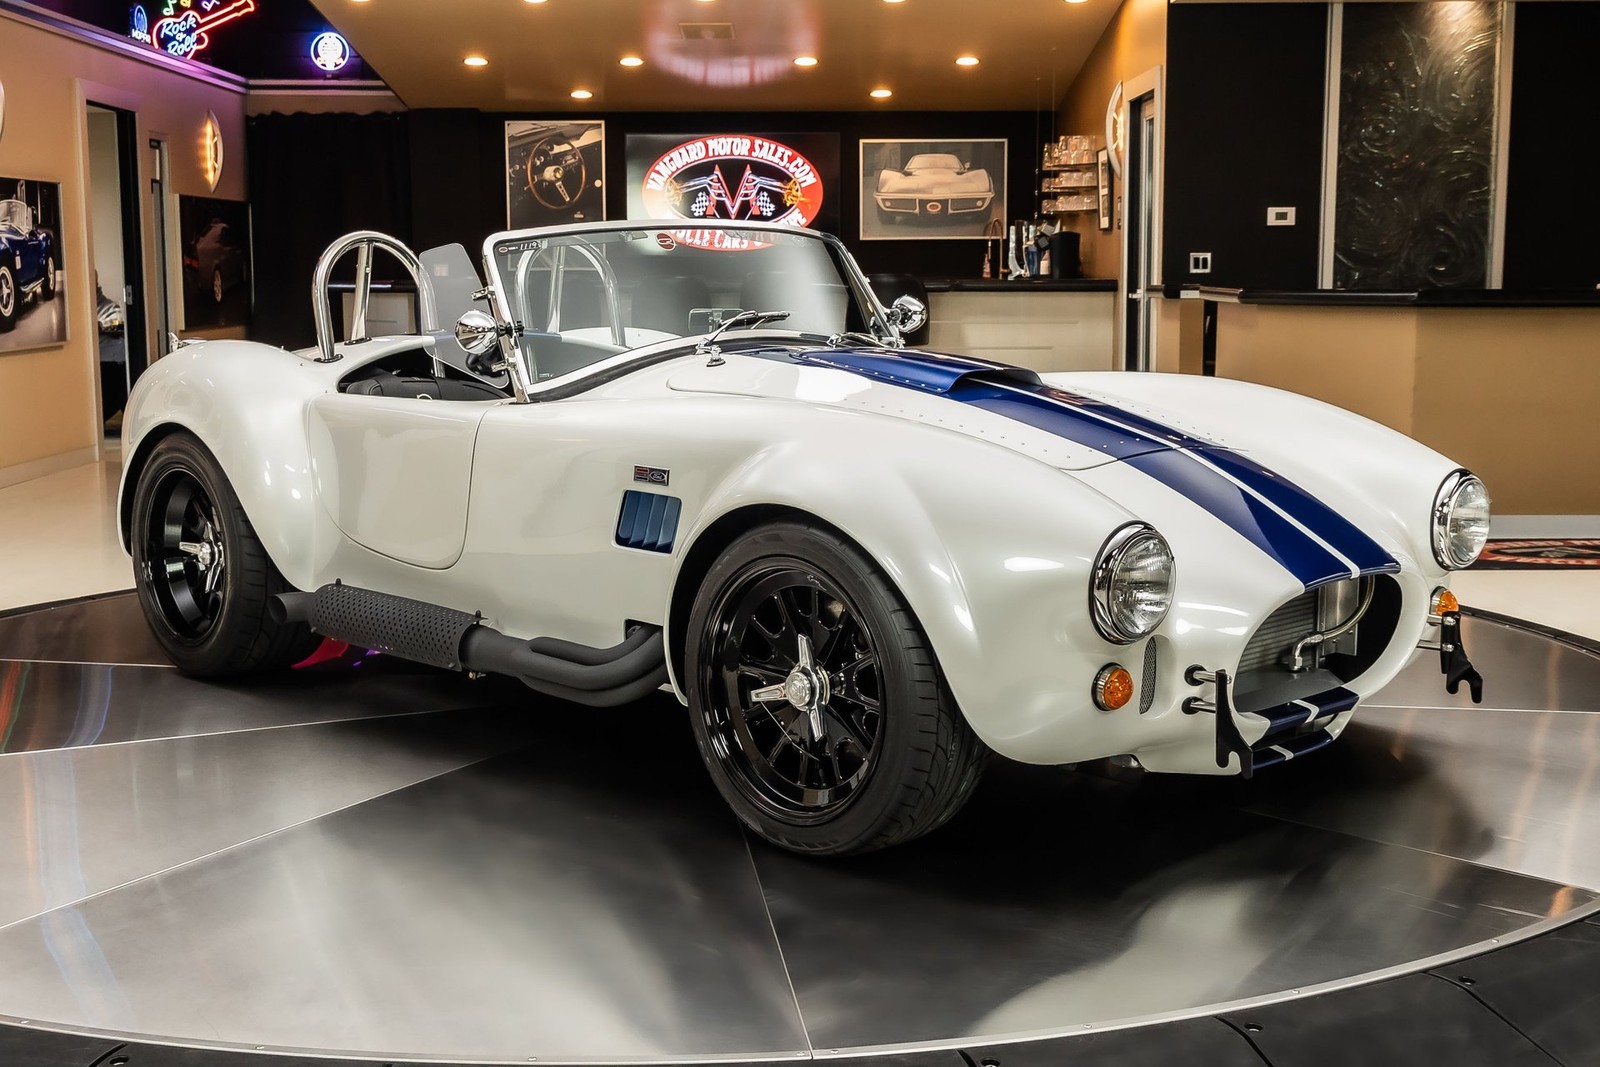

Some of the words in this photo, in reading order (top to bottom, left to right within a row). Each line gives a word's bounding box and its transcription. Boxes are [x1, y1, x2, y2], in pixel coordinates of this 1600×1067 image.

[161, 14, 197, 38] Rock
[167, 33, 197, 56] Roll
[646, 141, 706, 190] VANGUARD
[707, 138, 750, 156] MOTOR
[752, 139, 817, 188] SALES.COM
